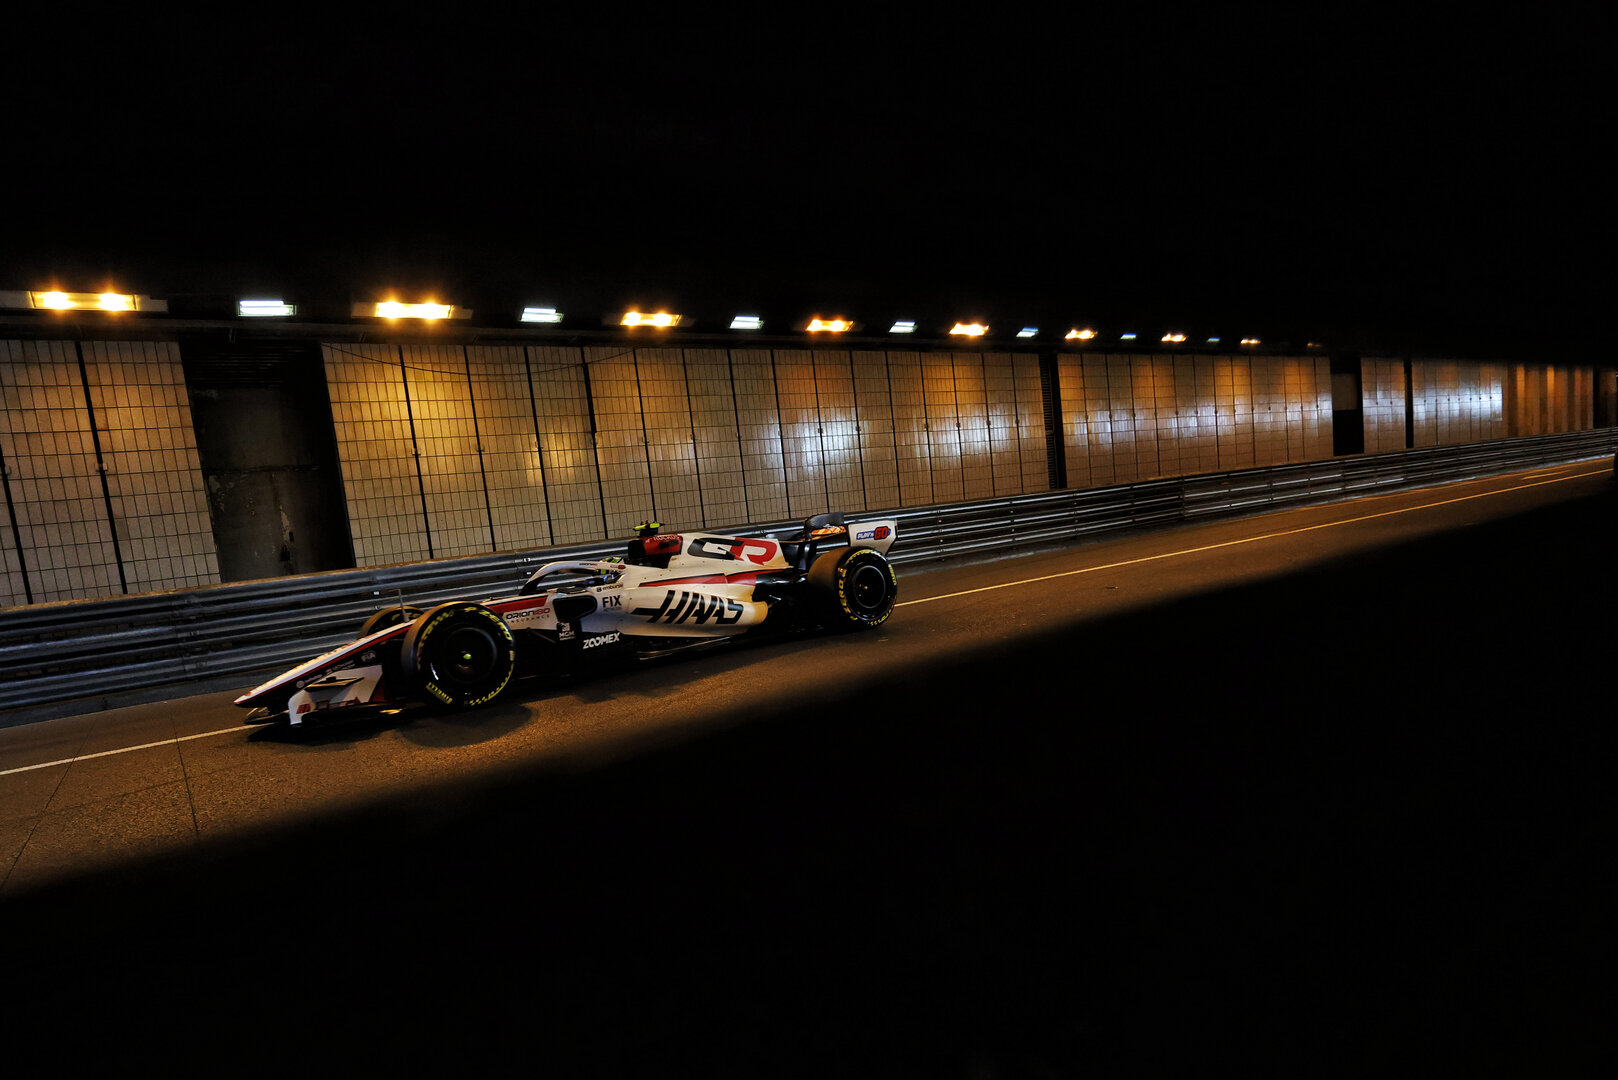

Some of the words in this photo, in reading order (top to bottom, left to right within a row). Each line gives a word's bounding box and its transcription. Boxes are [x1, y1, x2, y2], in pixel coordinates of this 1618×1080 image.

[687, 537, 778, 566] GR
[602, 595, 622, 608] FIX
[630, 590, 744, 625] HAAS
[582, 632, 620, 650] ZOOMEX
